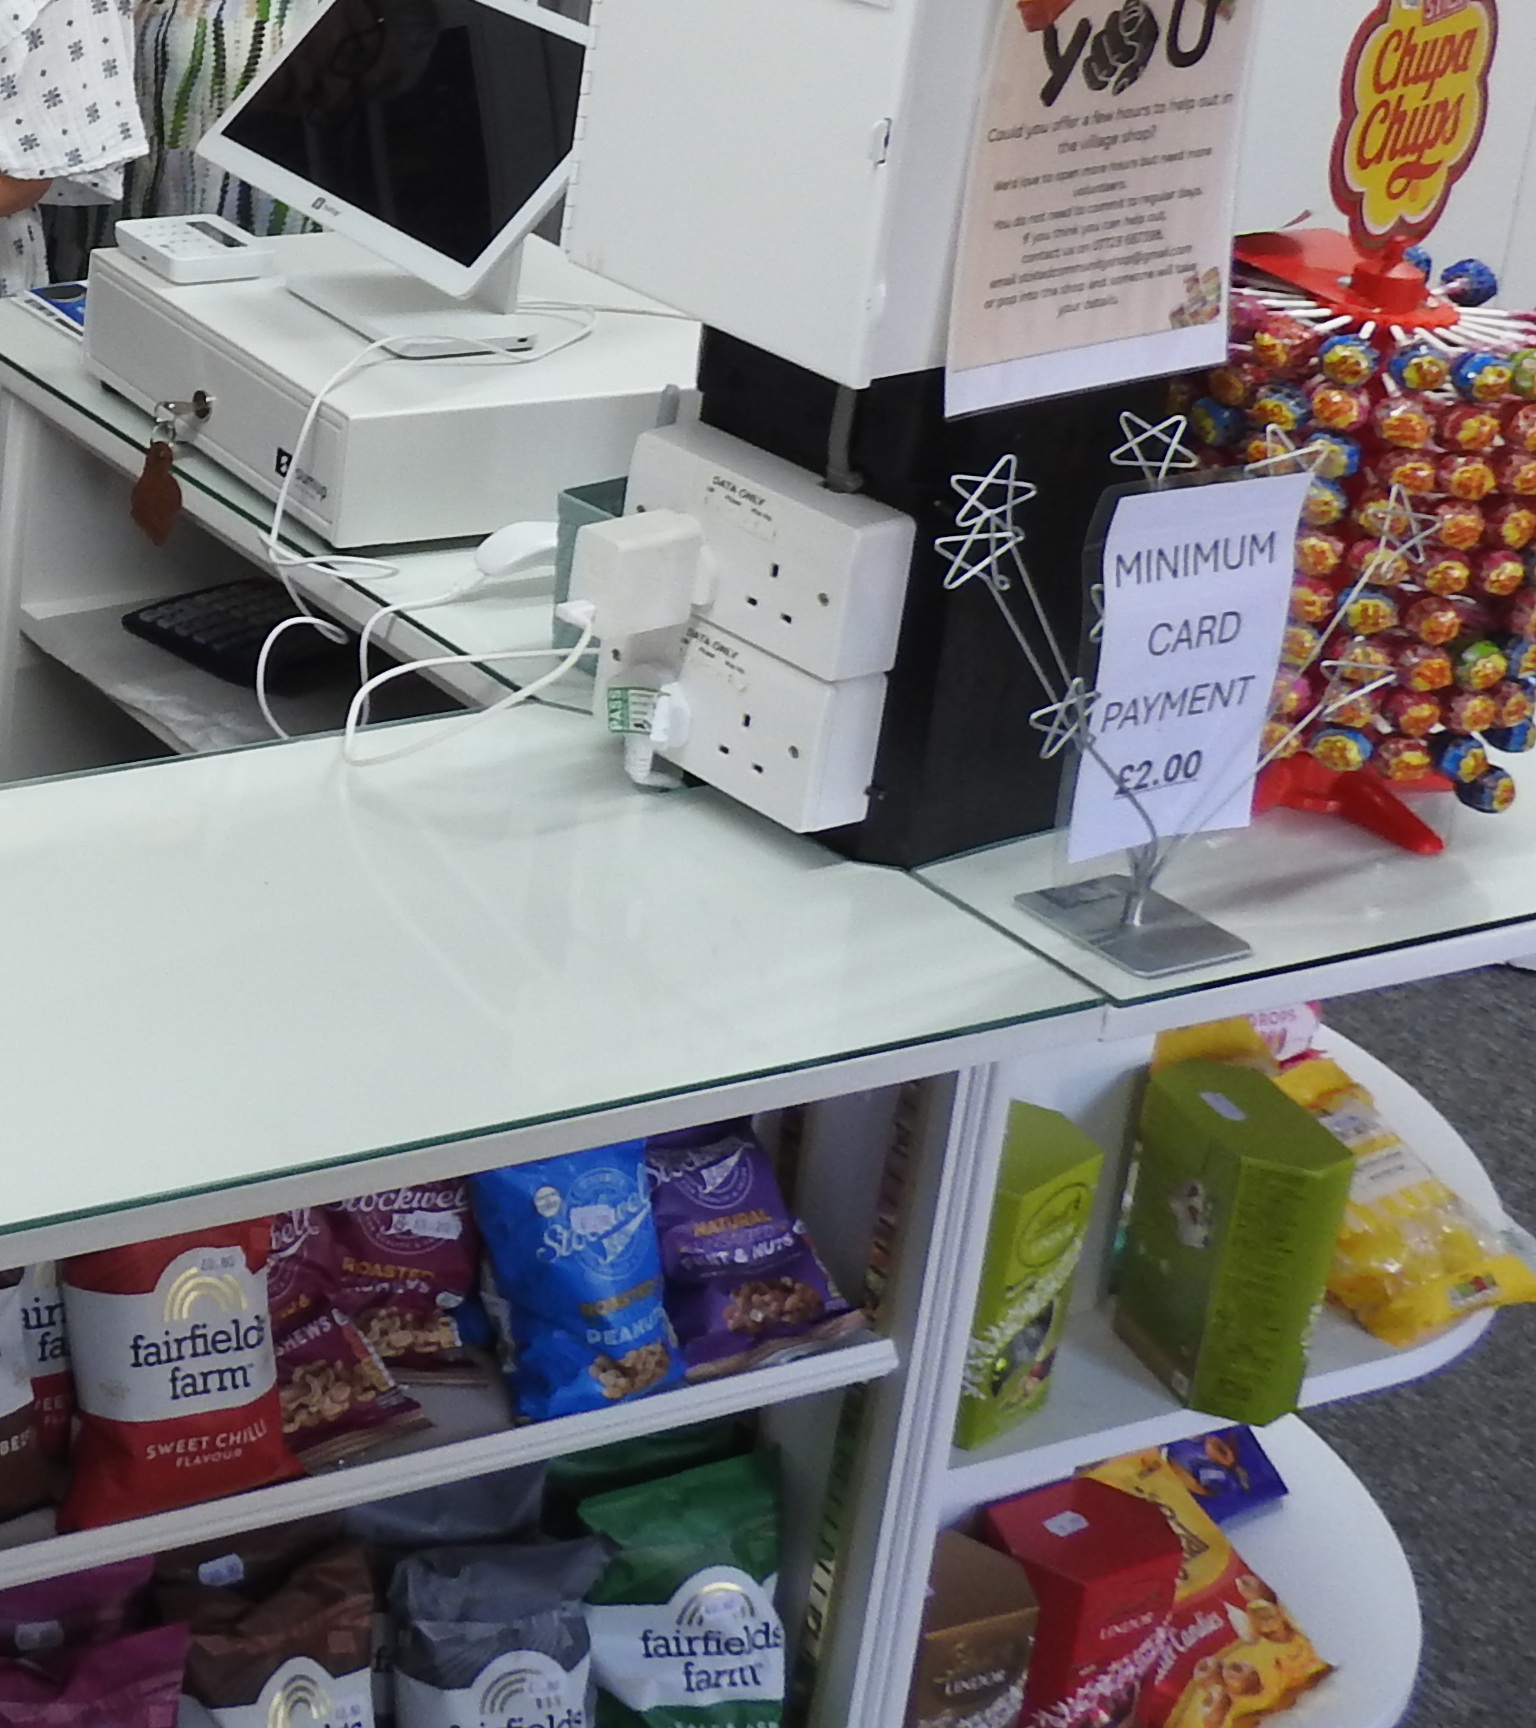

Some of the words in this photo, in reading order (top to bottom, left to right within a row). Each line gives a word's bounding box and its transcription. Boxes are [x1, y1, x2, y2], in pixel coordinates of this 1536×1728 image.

[1373, 25, 1479, 101] Chupa
[988, 126, 1023, 143] Could
[1355, 92, 1467, 172] Chups
[1114, 530, 1278, 589] MINIMUM
[1147, 610, 1242, 657] CARD
[1099, 674, 1257, 733] PAYMENT
[129, 1315, 266, 1368] fairfield
[169, 1365, 251, 1401] farm
[146, 1435, 210, 1460] SWEET
[215, 1419, 269, 1448] CHILLI
[682, 1660, 763, 1693] farm
